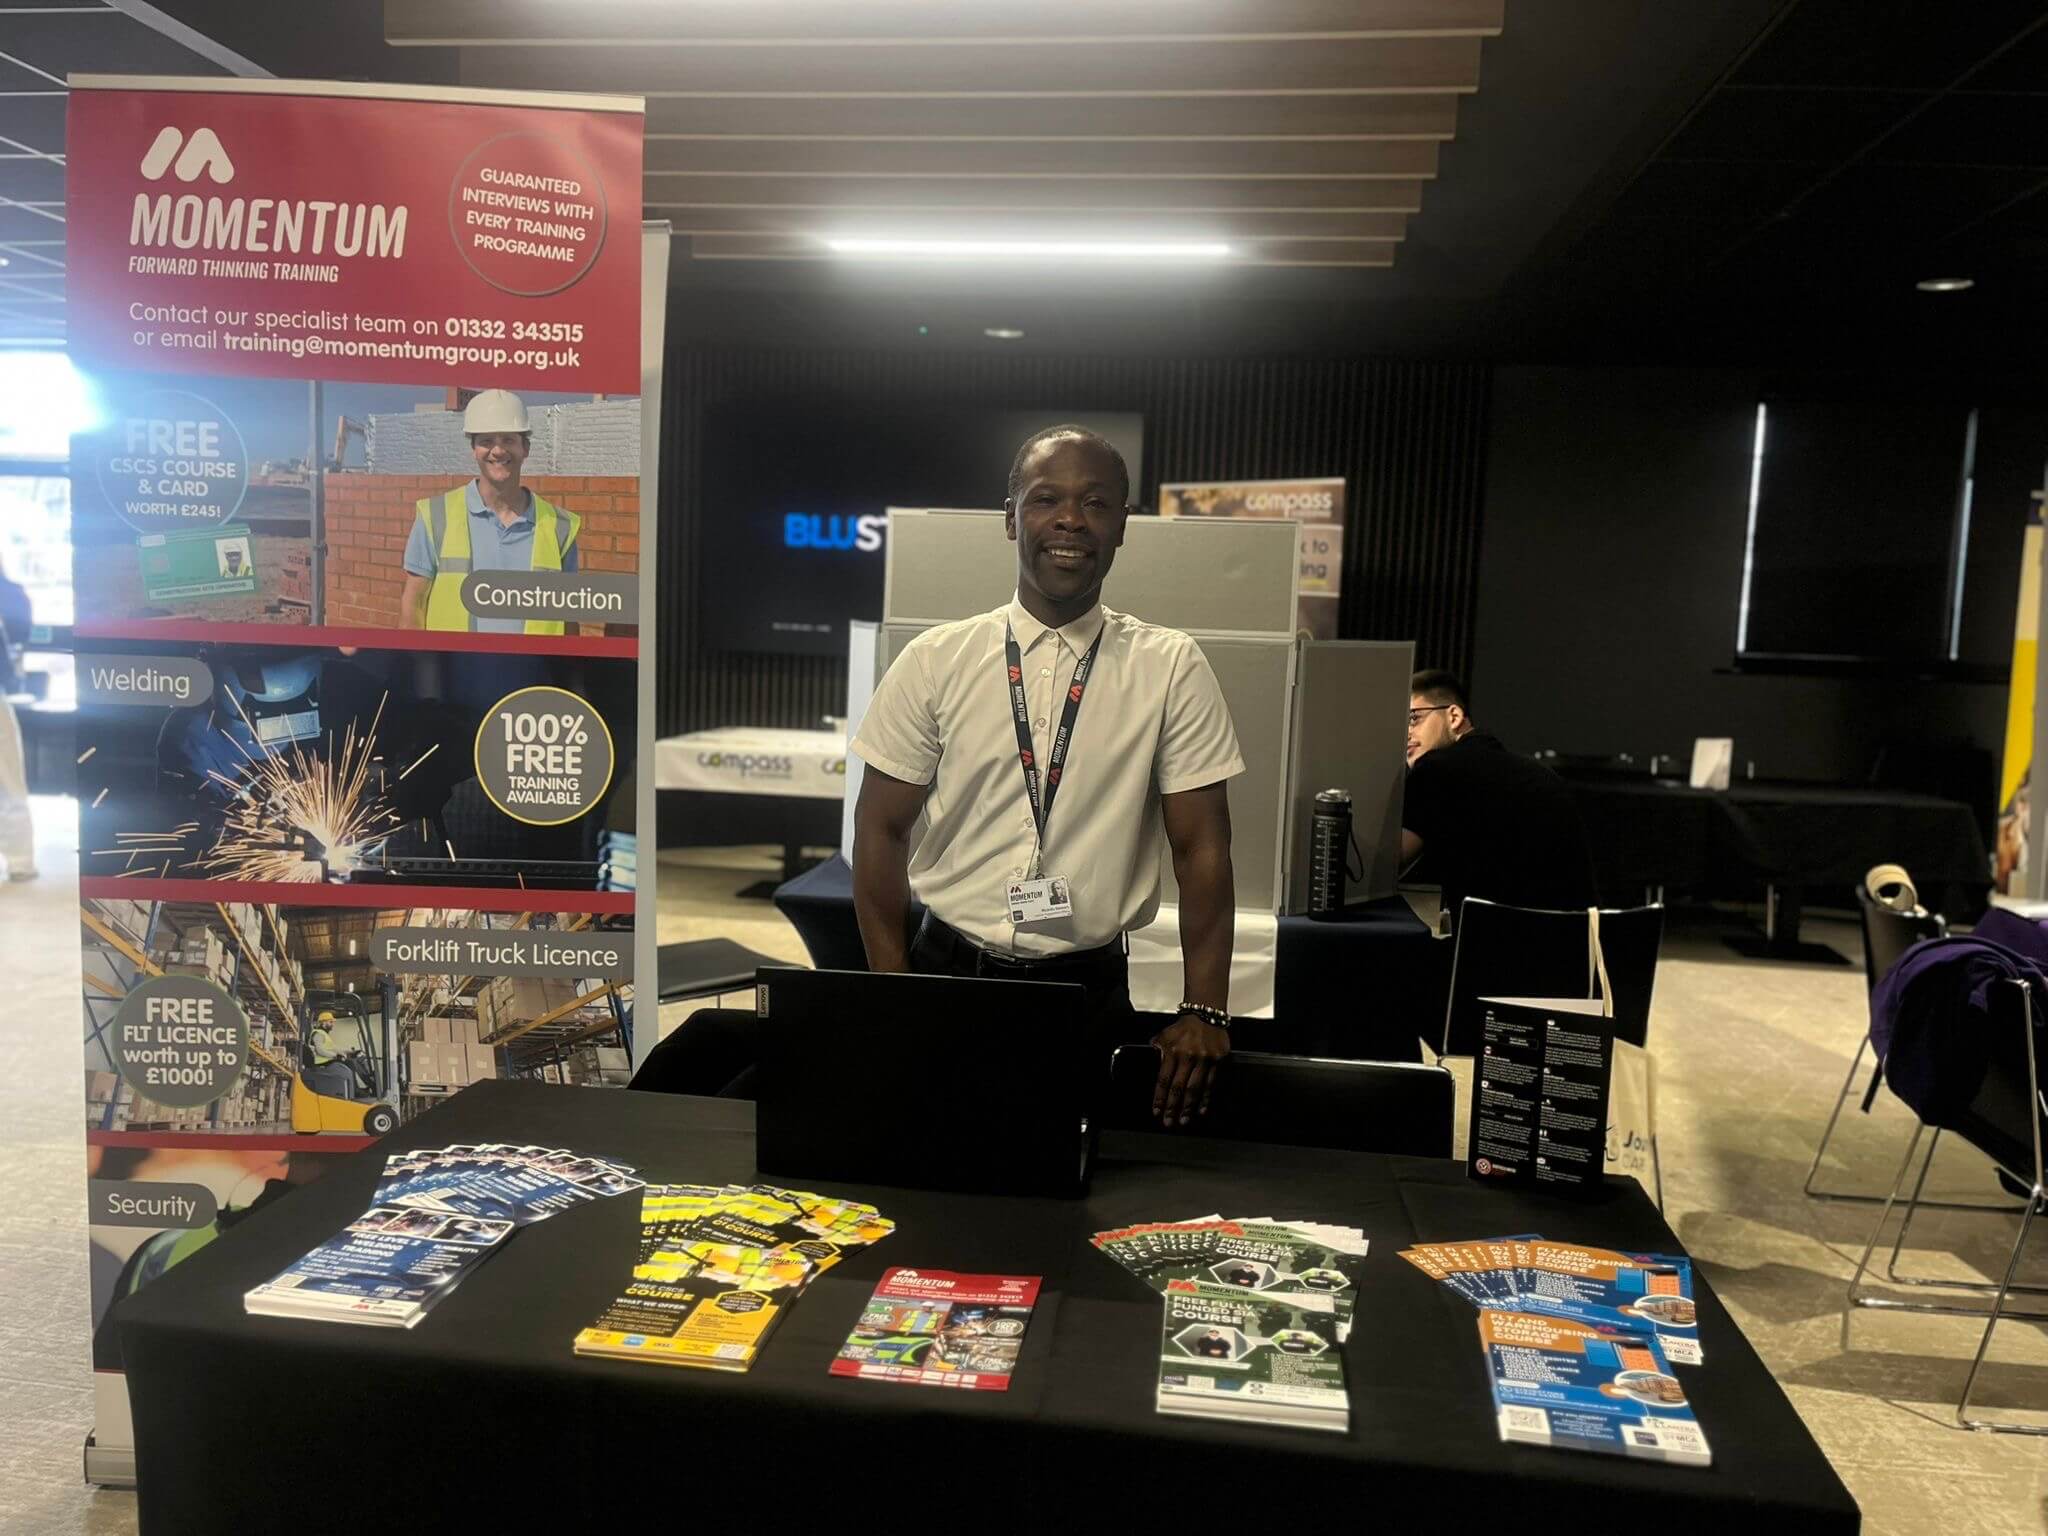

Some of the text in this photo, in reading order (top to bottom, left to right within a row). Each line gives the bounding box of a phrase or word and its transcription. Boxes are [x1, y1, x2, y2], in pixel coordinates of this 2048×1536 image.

[480, 168, 581, 195] GUARANTEED
[463, 187, 594, 220] INTERVIEWS WITH
[130, 193, 408, 259] MOMENTUM
[466, 210, 586, 241] EVERY TRAINING
[474, 234, 575, 262] PROGRAMME
[129, 256, 340, 283] FORWARD THINKING TRAINING
[129, 302, 584, 343] Contact our specialist team on 01332 343515
[133, 330, 580, 370] or email training@momentumgroup.org.uk
[125, 418, 220, 457] FREE
[110, 457, 237, 479] CSCS COURSE
[137, 479, 209, 497] & CARD
[125, 501, 178, 516] WORTH
[473, 583, 622, 611] Construction
[91, 667, 190, 698] Welding
[500, 712, 588, 745] 100%
[506, 744, 583, 774] FREE
[697, 751, 792, 779] compass
[508, 776, 579, 791] TRAINING
[506, 790, 581, 805] AVAILABLE
[386, 939, 618, 967] Forklift Truck Licence
[146, 997, 213, 1024] FREE
[124, 1025, 237, 1045] FLT LICENCE
[123, 1047, 237, 1068] worth up to
[146, 1067, 213, 1086] £1000!
[108, 1193, 196, 1222] Security
[1218, 1242, 1272, 1255] FUNDED
[1221, 1237, 1292, 1250] FREE FULLY
[1536, 1246, 1560, 1254] FLT
[1215, 1247, 1279, 1263] COURSE
[1536, 1251, 1633, 1268] WAREHOUSING
[1536, 1256, 1596, 1269] STORAGE
[1536, 1260, 1588, 1273] COURSE
[891, 1276, 956, 1288] MOMENTUM
[625, 1287, 695, 1301] COURSE
[1174, 1296, 1253, 1311] FREE FULLY
[1171, 1310, 1244, 1325] COURSE
[1173, 1302, 1232, 1315] FUNDED
[1489, 1313, 1548, 1326] FLT AND
[1492, 1319, 1599, 1339] WAREHOUSING
[1492, 1326, 1559, 1339] STORAGE
[1494, 1332, 1553, 1345] COURSE
